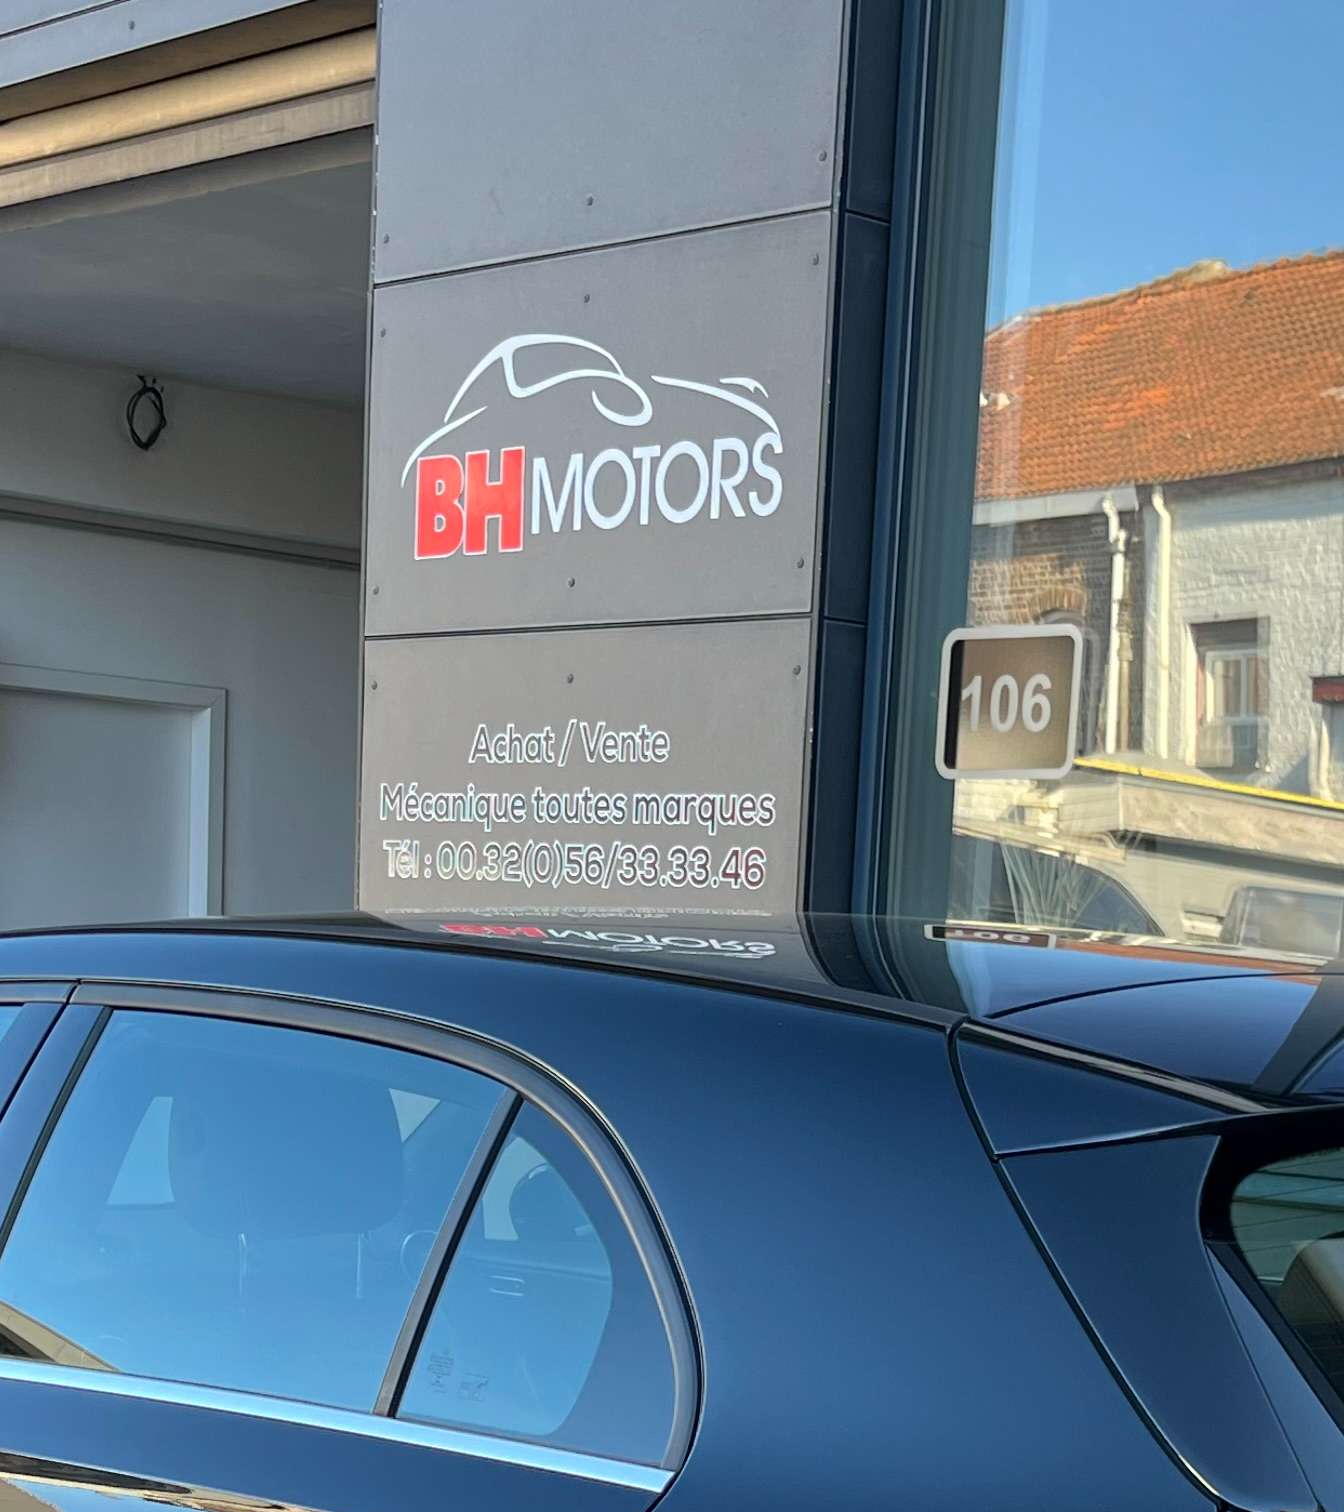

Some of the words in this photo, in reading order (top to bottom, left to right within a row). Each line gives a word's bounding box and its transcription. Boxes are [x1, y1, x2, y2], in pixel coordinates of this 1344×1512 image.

[414, 446, 526, 560] BH
[531, 431, 783, 535] MOTORS
[961, 673, 1052, 733] 106
[468, 724, 554, 764] Achat
[558, 719, 577, 766] /
[580, 721, 670, 764] Vente
[379, 782, 527, 832] Mécanique
[531, 787, 626, 825] toutes
[632, 793, 776, 835] marques
